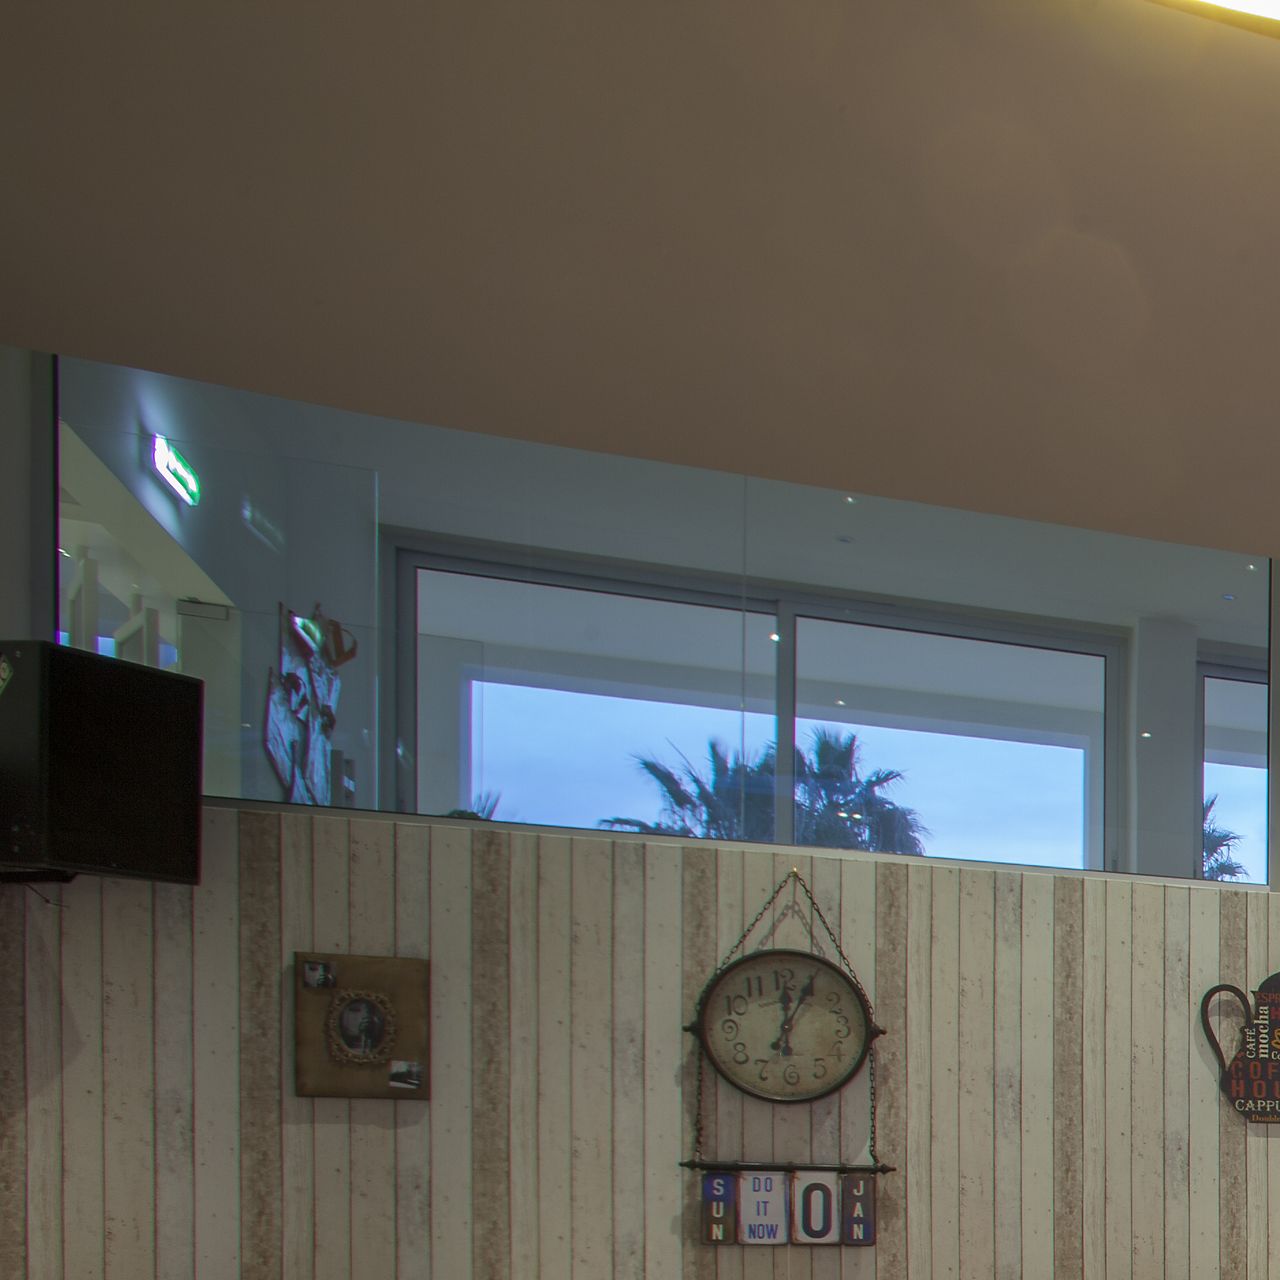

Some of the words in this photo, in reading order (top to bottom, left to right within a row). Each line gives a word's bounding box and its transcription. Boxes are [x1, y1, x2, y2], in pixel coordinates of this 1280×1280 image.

[746, 976, 763, 997] 11
[726, 994, 748, 1016] 10
[826, 992, 842, 1014] 2
[722, 1019, 738, 1041] 9
[835, 1015, 851, 1038] 3
[1254, 1006, 1269, 1059] mocha
[733, 1042, 749, 1064] 8
[754, 1059, 768, 1081] 7
[784, 1064, 800, 1085] 6
[813, 1058, 827, 1079] 5
[752, 1177, 773, 1192] DO
[712, 1179, 725, 1240] SUN
[756, 1201, 769, 1216] IT
[853, 1180, 864, 1240] JAN
[748, 1224, 778, 1239] NOW
